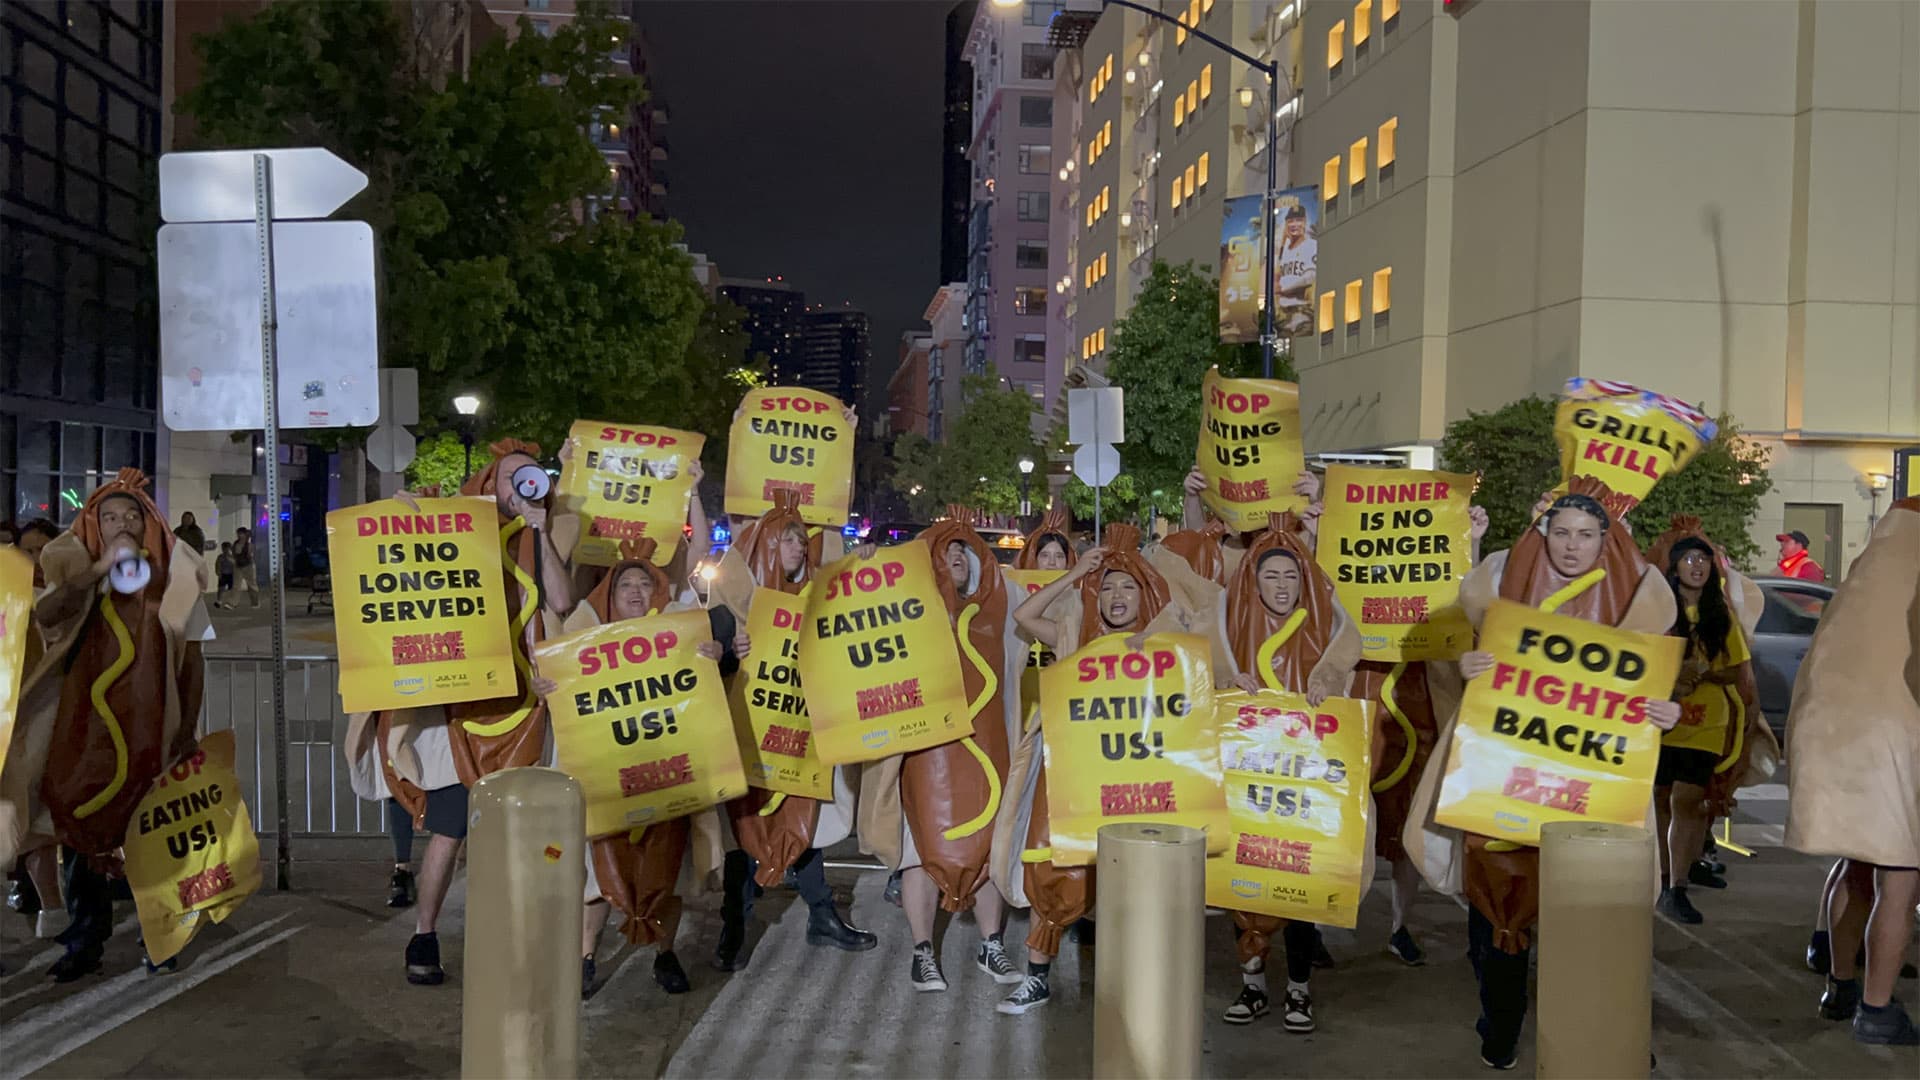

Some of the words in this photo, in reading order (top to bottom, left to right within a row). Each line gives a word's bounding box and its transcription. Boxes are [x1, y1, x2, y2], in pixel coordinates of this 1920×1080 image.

[761, 397, 830, 414] STOP
[1210, 384, 1270, 414] STOP
[600, 427, 677, 449] STOP
[751, 417, 838, 442] EATING
[770, 443, 815, 467] US!
[1216, 444, 1261, 467] US!
[1583, 438, 1660, 481] KILL
[602, 481, 651, 505] US!
[1346, 482, 1450, 505] DINNER
[357, 513, 474, 537] DINNER
[1360, 512, 1385, 531] IS
[1392, 508, 1433, 530] NO
[378, 544, 406, 564] IS
[415, 542, 459, 563] NO
[1340, 534, 1452, 558] LONGER
[359, 569, 482, 594] LONGER
[825, 561, 905, 601] STOP
[1337, 562, 1452, 584] SERVED!
[361, 596, 486, 624] SERVED!
[816, 597, 925, 640] EATING
[578, 630, 679, 676] STOP
[848, 633, 909, 669] US!
[1517, 627, 1646, 681] FOOD
[757, 660, 802, 689] LON
[1077, 650, 1176, 683] STOP
[575, 668, 698, 716] EATING
[751, 688, 809, 718] SERV
[1491, 662, 1649, 724] FIGHTS
[1069, 693, 1193, 722] EATING
[1236, 704, 1340, 741] STOP
[611, 707, 679, 746] US!
[1492, 706, 1628, 766] BACK!
[1101, 731, 1165, 761] US!
[159, 750, 207, 788] OP
[139, 784, 223, 835] EATING
[1247, 784, 1312, 820] US!
[166, 820, 218, 860] US!
[1232, 878, 1262, 890] prime
[1273, 886, 1296, 895] JULY
